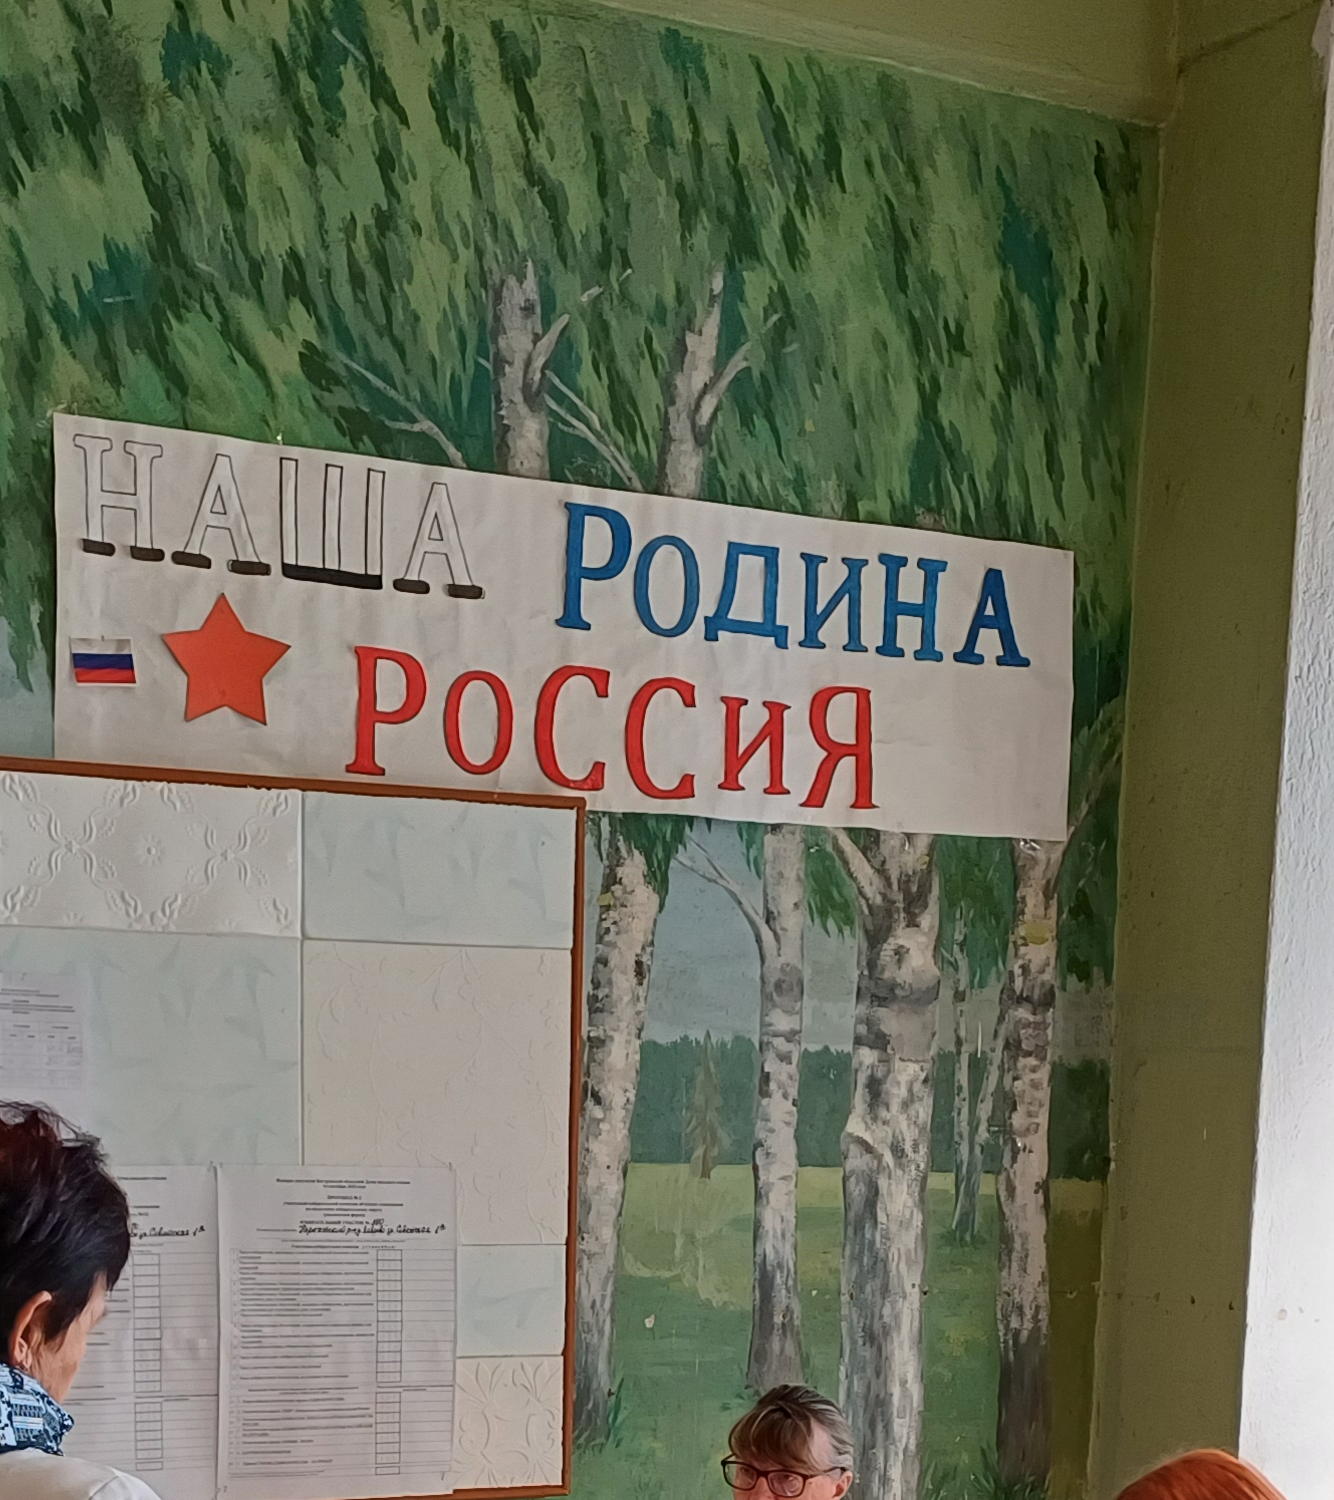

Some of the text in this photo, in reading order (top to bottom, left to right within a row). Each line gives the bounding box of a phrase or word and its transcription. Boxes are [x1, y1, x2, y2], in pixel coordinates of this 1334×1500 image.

[72, 433, 1032, 668] НАША РОДИНА
[344, 644, 879, 811] РОССИЯ
